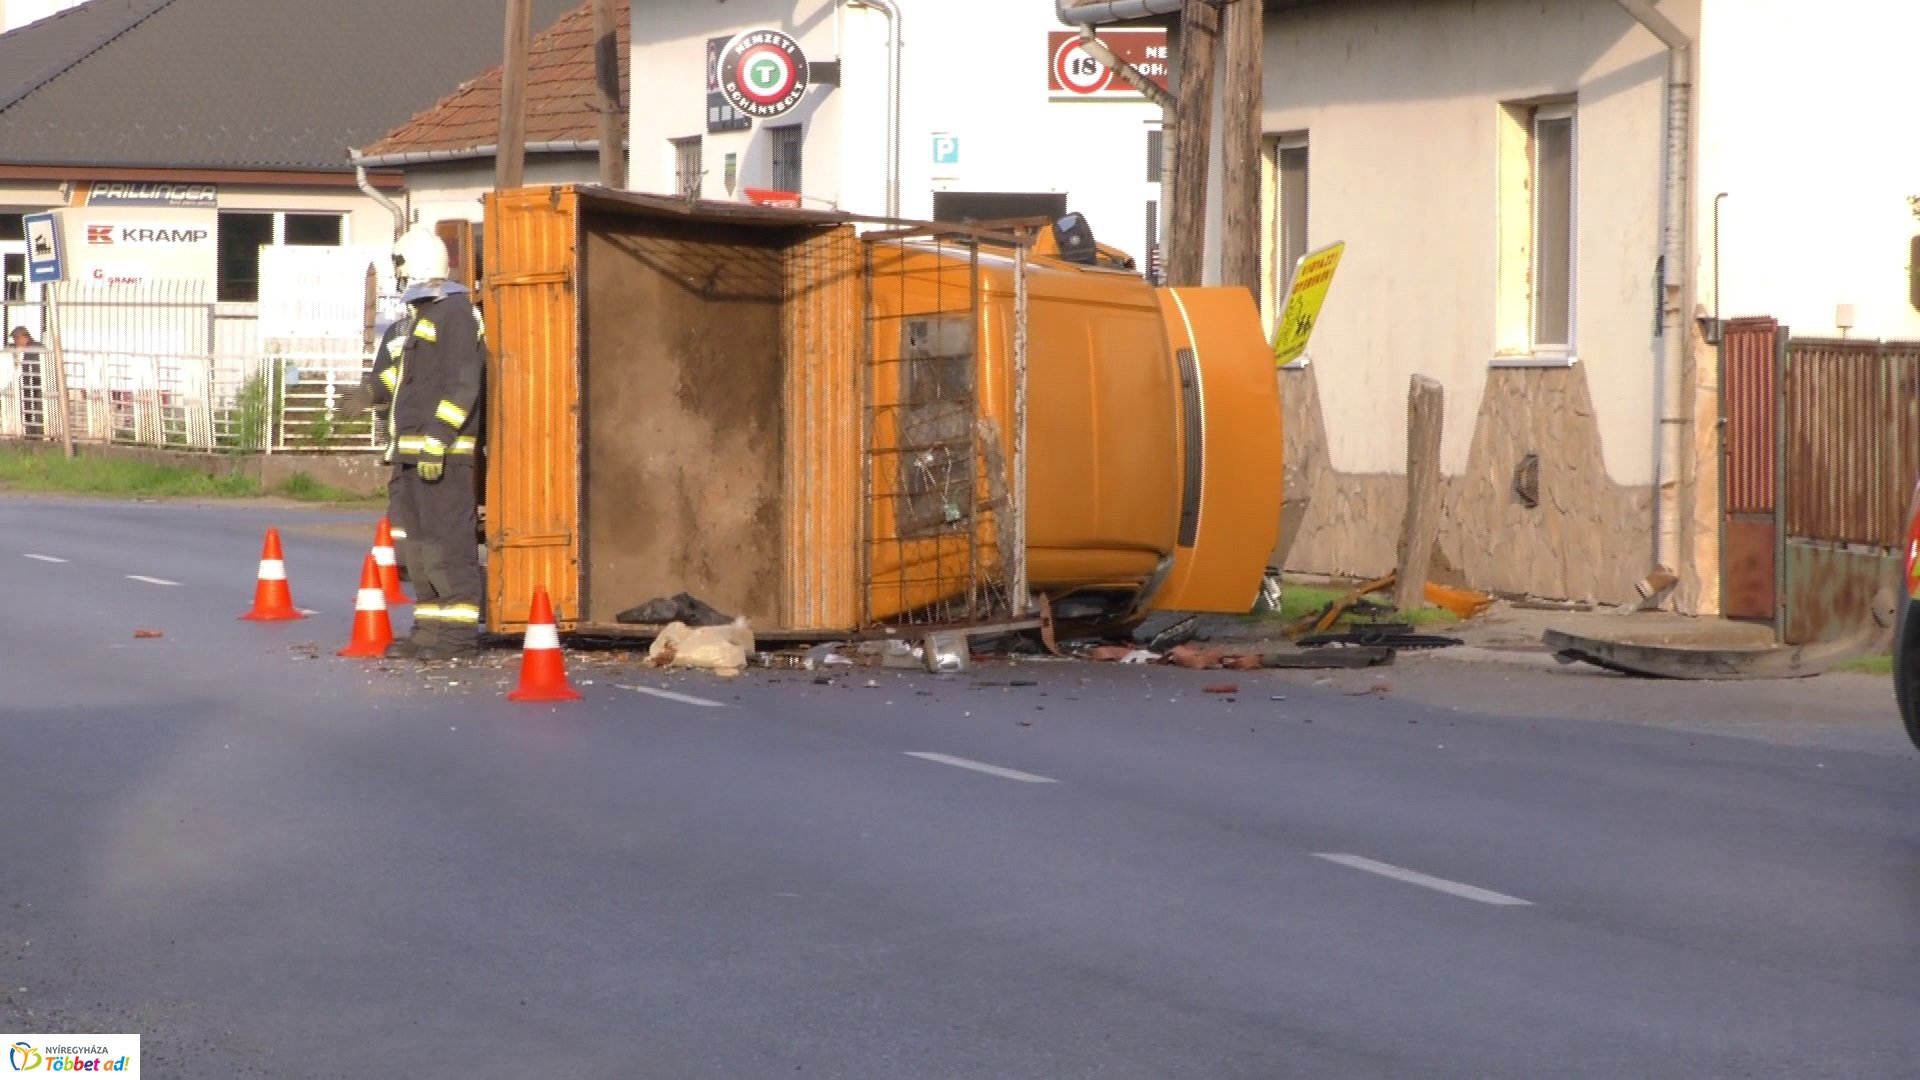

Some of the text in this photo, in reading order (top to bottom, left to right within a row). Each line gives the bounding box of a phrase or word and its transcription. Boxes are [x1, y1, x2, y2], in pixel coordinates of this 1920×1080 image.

[735, 33, 796, 55] NEMZETI
[755, 65, 776, 83] T
[1072, 57, 1097, 76] 18
[937, 139, 954, 161] P
[92, 183, 217, 200] PRILLINGER
[122, 228, 208, 243] KRAMP
